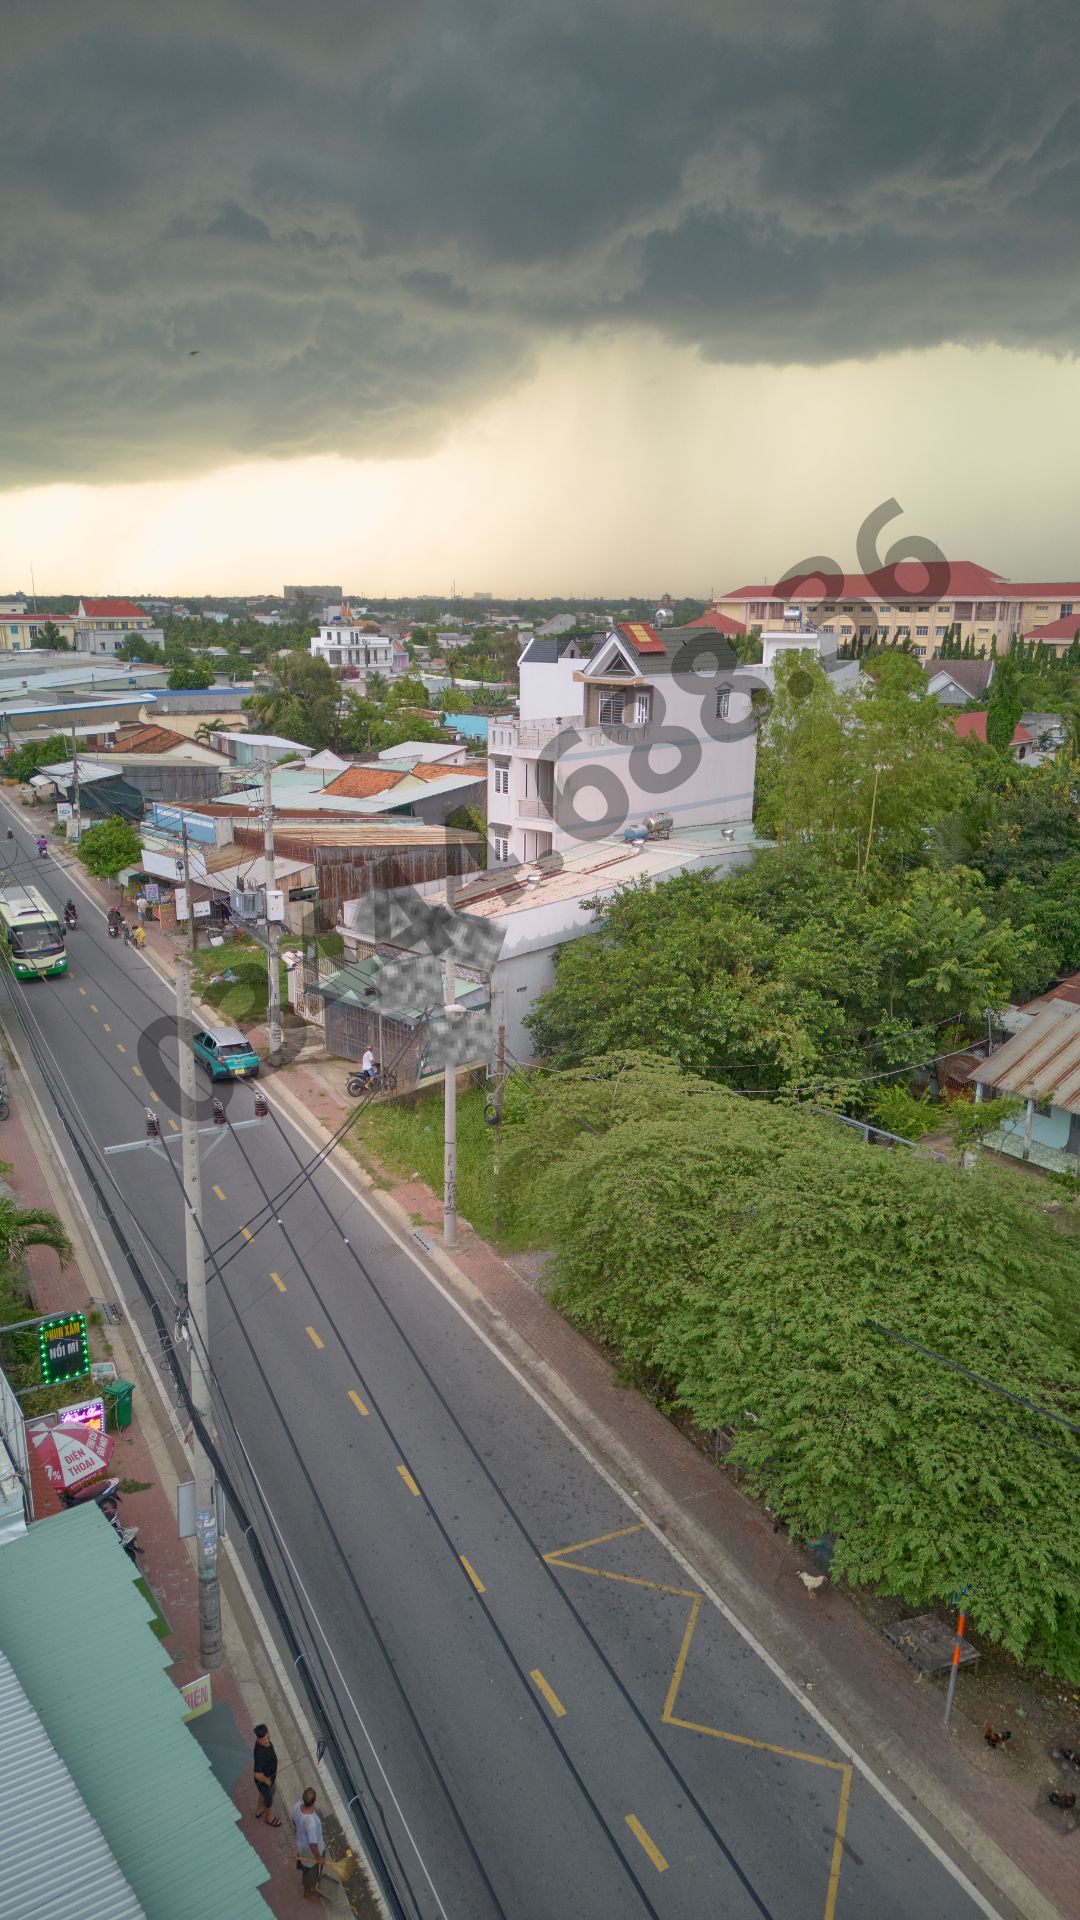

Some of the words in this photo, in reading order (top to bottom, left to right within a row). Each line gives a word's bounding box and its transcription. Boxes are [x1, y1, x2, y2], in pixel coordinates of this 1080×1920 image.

[49, 1342, 66, 1360] NỐI
[64, 1448, 86, 1465] ĐIỆN
[68, 1457, 96, 1477] THOẠI
